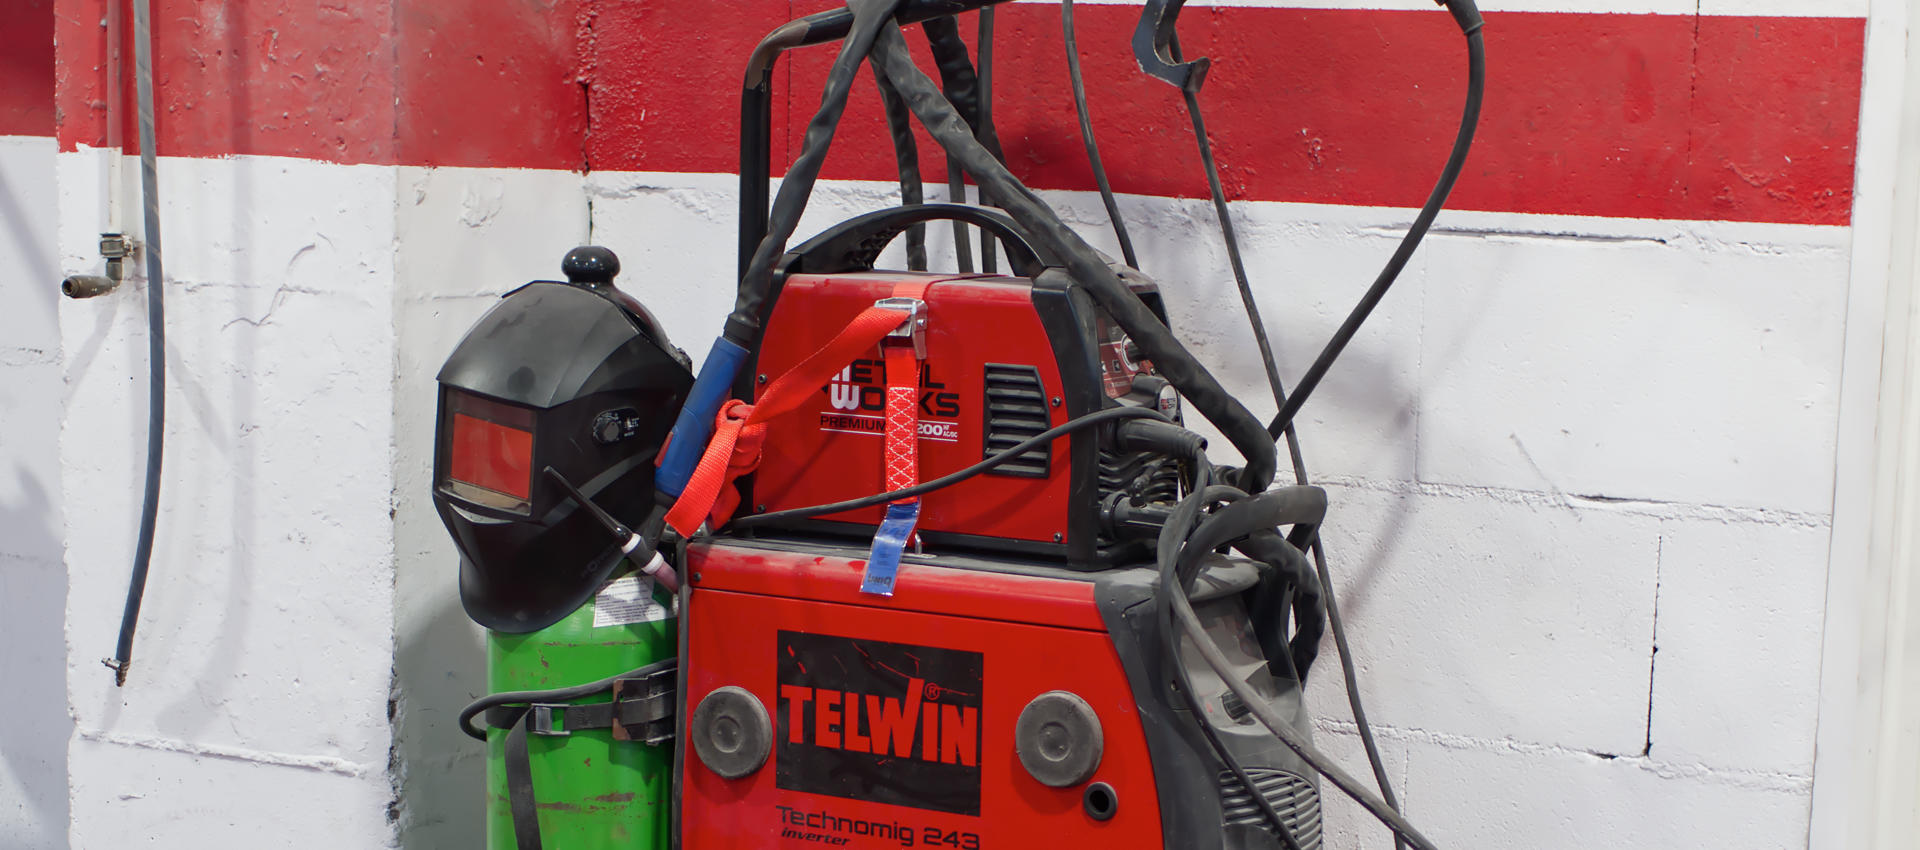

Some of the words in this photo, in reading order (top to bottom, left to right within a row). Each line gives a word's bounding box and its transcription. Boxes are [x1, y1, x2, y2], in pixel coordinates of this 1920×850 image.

[831, 383, 960, 418] WOKS
[820, 415, 886, 431] PREMIUM
[781, 677, 978, 767] TELWIN
[776, 805, 914, 847] Technomig
[923, 827, 980, 850] 243
[781, 827, 851, 846] inverter
